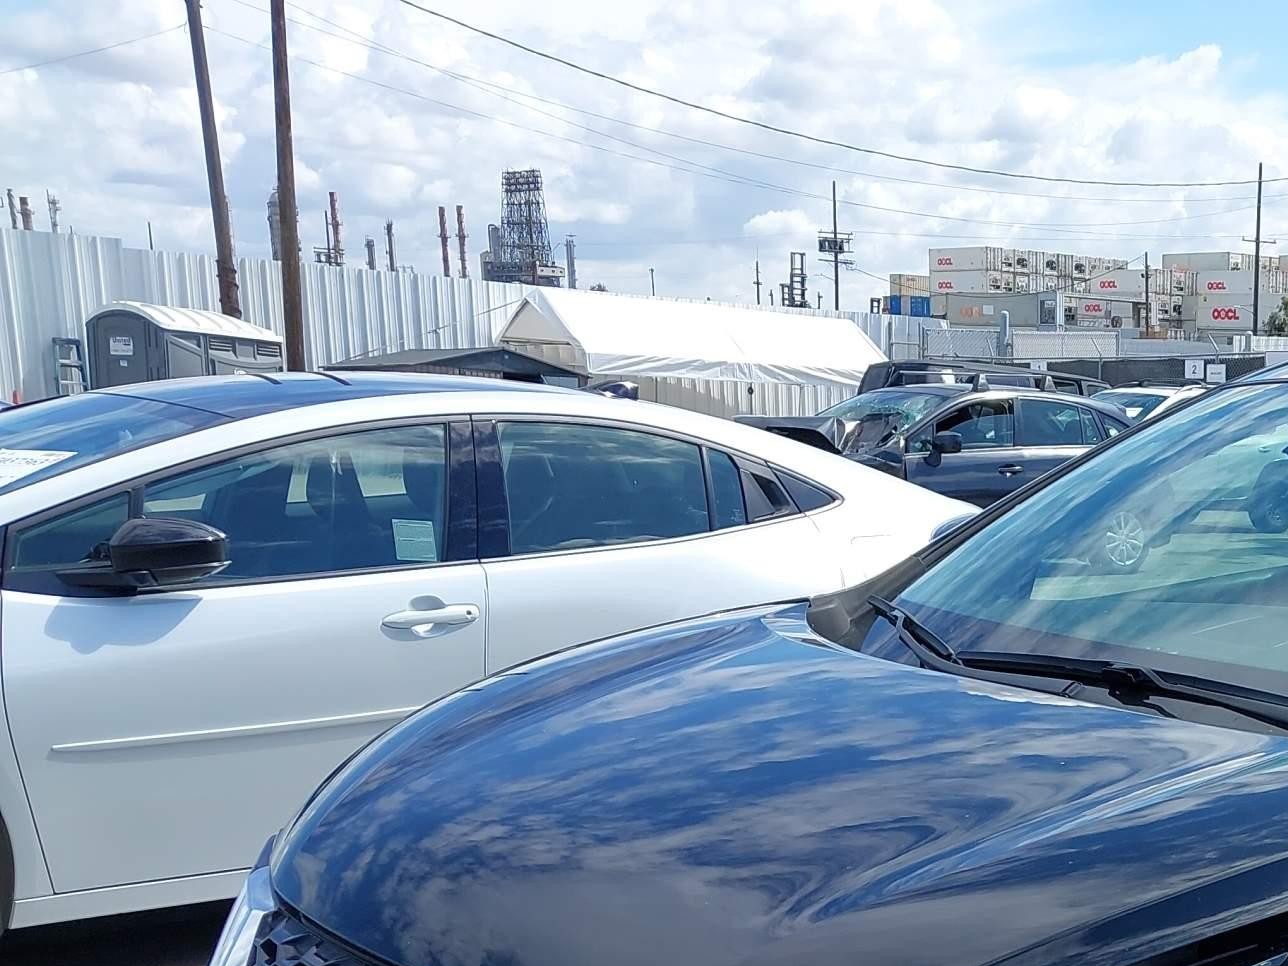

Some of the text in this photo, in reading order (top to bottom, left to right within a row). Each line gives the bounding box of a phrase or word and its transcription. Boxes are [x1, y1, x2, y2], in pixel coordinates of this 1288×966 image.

[1099, 280, 1118, 288] OOCL
[1207, 281, 1226, 290] OOCL
[1084, 303, 1102, 312] OOCL
[1212, 307, 1239, 320] OOCL
[1191, 364, 1197, 374] 2
